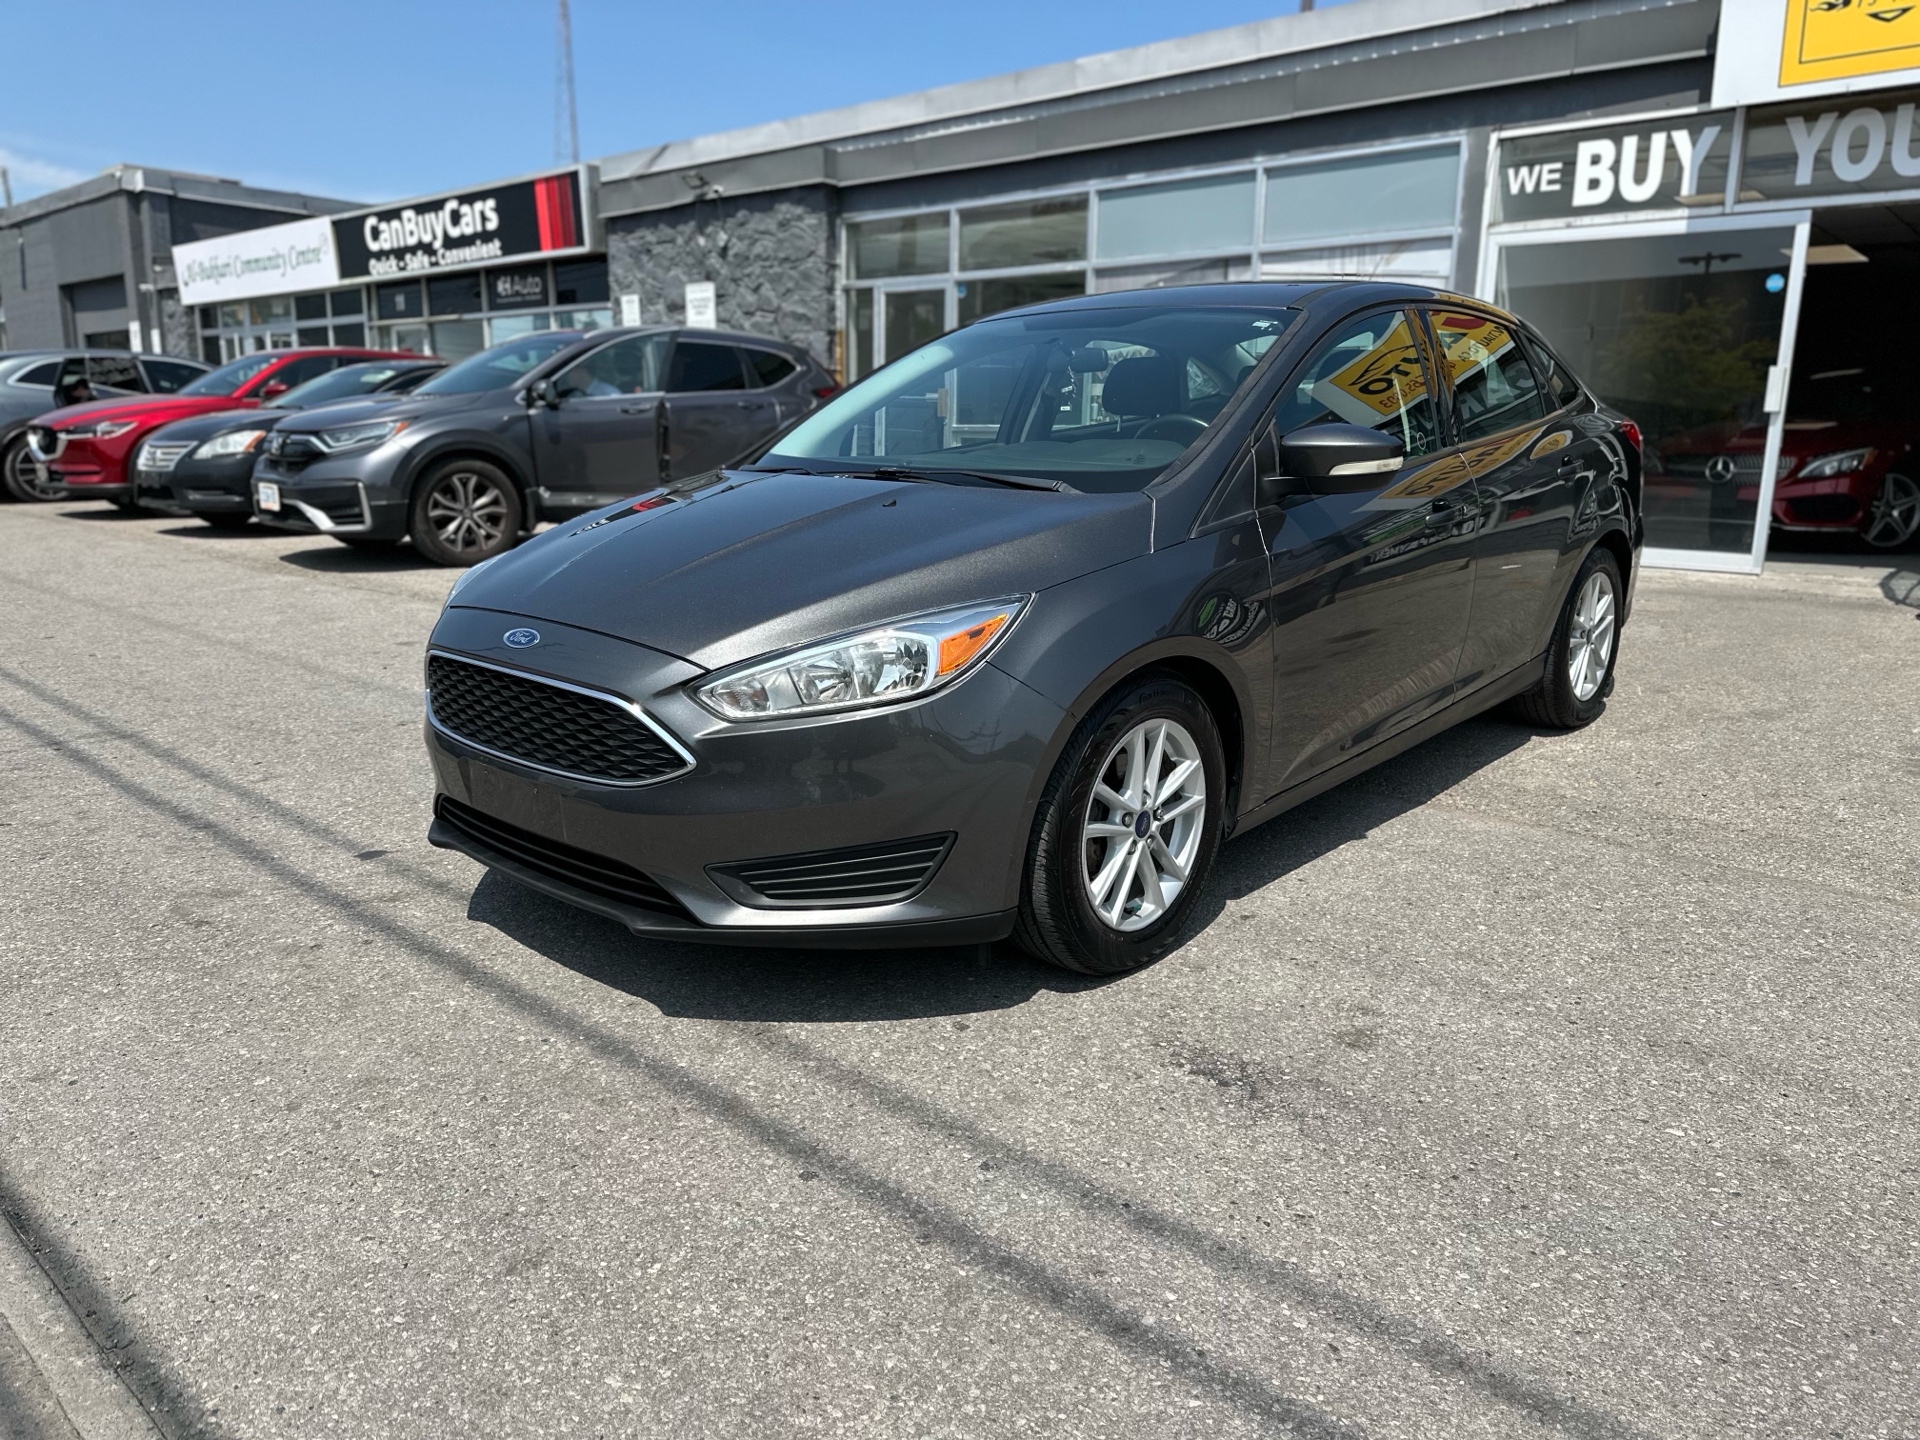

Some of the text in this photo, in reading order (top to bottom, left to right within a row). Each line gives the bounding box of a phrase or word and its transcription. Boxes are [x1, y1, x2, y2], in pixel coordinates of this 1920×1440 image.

[1506, 162, 1563, 196] WE
[1572, 125, 1721, 208] BUY
[364, 197, 500, 252] CanBuyCars
[368, 238, 503, 277] Quick Safe Convenient
